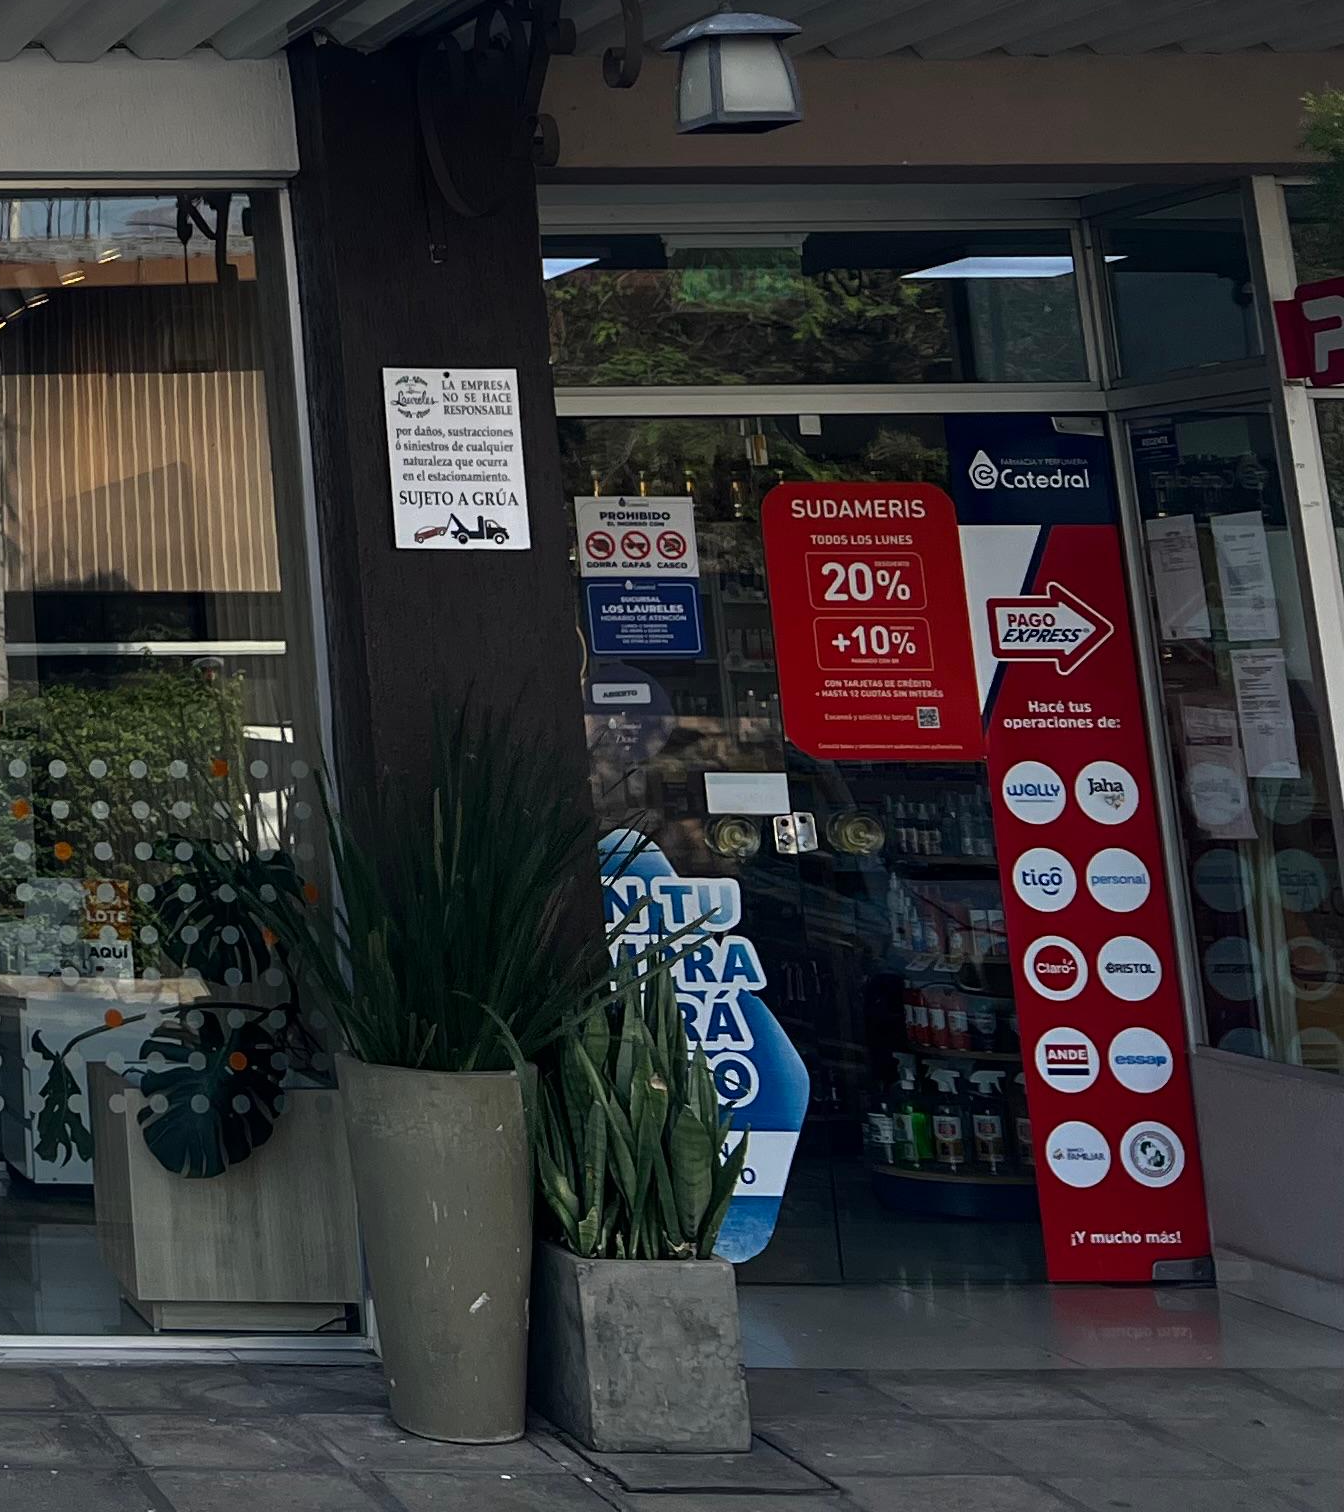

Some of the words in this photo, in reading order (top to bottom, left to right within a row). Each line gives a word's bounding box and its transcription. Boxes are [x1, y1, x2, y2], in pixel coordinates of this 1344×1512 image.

[441, 380, 455, 391] LA
[461, 380, 511, 391] EMPRESA
[442, 392, 459, 403] NO
[464, 392, 477, 403] SE
[482, 392, 512, 403] HACE
[443, 405, 513, 416] RESPONSABLE
[395, 427, 412, 440] por
[414, 426, 446, 438] daños,
[447, 426, 514, 437] sustracciones
[403, 441, 449, 452] siniestros
[451, 441, 464, 452] de
[466, 441, 514, 455] cualquier
[403, 457, 452, 467] naturaleza
[455, 458, 473, 470] que
[476, 458, 508, 467] ocurra
[403, 473, 414, 482] en
[416, 471, 425, 481] el
[428, 471, 511, 482] estacionamiento.
[1000, 468, 1090, 489] Catedral
[399, 490, 454, 509] SUJETO
[458, 493, 469, 506] A
[472, 488, 519, 506] GRÚA
[791, 499, 926, 519] SUDAMERIS
[599, 511, 672, 521] PROHIBIDO
[810, 535, 848, 545] TODOS
[850, 535, 873, 545] LOS
[875, 535, 913, 545] LUNES
[657, 561, 688, 569] CASCO
[821, 562, 911, 602] 20%
[602, 604, 624, 614] LOS
[627, 604, 684, 614] LAURELES
[1007, 613, 1056, 627] PAGO
[831, 625, 916, 655] +10%
[1002, 628, 1082, 643] EXPRESS
[824, 680, 842, 688] CON
[844, 679, 883, 688] TARJETAS
[884, 680, 895, 688] DE
[897, 678, 932, 688] CRÉDITO
[822, 690, 848, 698] HASTA
[860, 690, 892, 698] CUOTAS
[893, 690, 907, 698] SIN
[1028, 700, 1065, 713] Hacé
[1069, 701, 1092, 713] tus
[1003, 717, 1094, 730] operaciones
[1098, 716, 1121, 728] de:
[1087, 777, 1124, 795] Jaha
[1091, 873, 1147, 886] personal
[659, 885, 731, 925] TU
[86, 909, 128, 923] LOTE
[89, 944, 128, 959] AQUÍ
[1036, 958, 1072, 974] Claro
[1105, 962, 1156, 974] BRISTOL
[1047, 1049, 1088, 1061] ANDE
[1114, 1054, 1167, 1067] essap
[1071, 1231, 1086, 1246] ¡Y
[1090, 1231, 1141, 1244] mucho
[1145, 1231, 1182, 1244] más!
